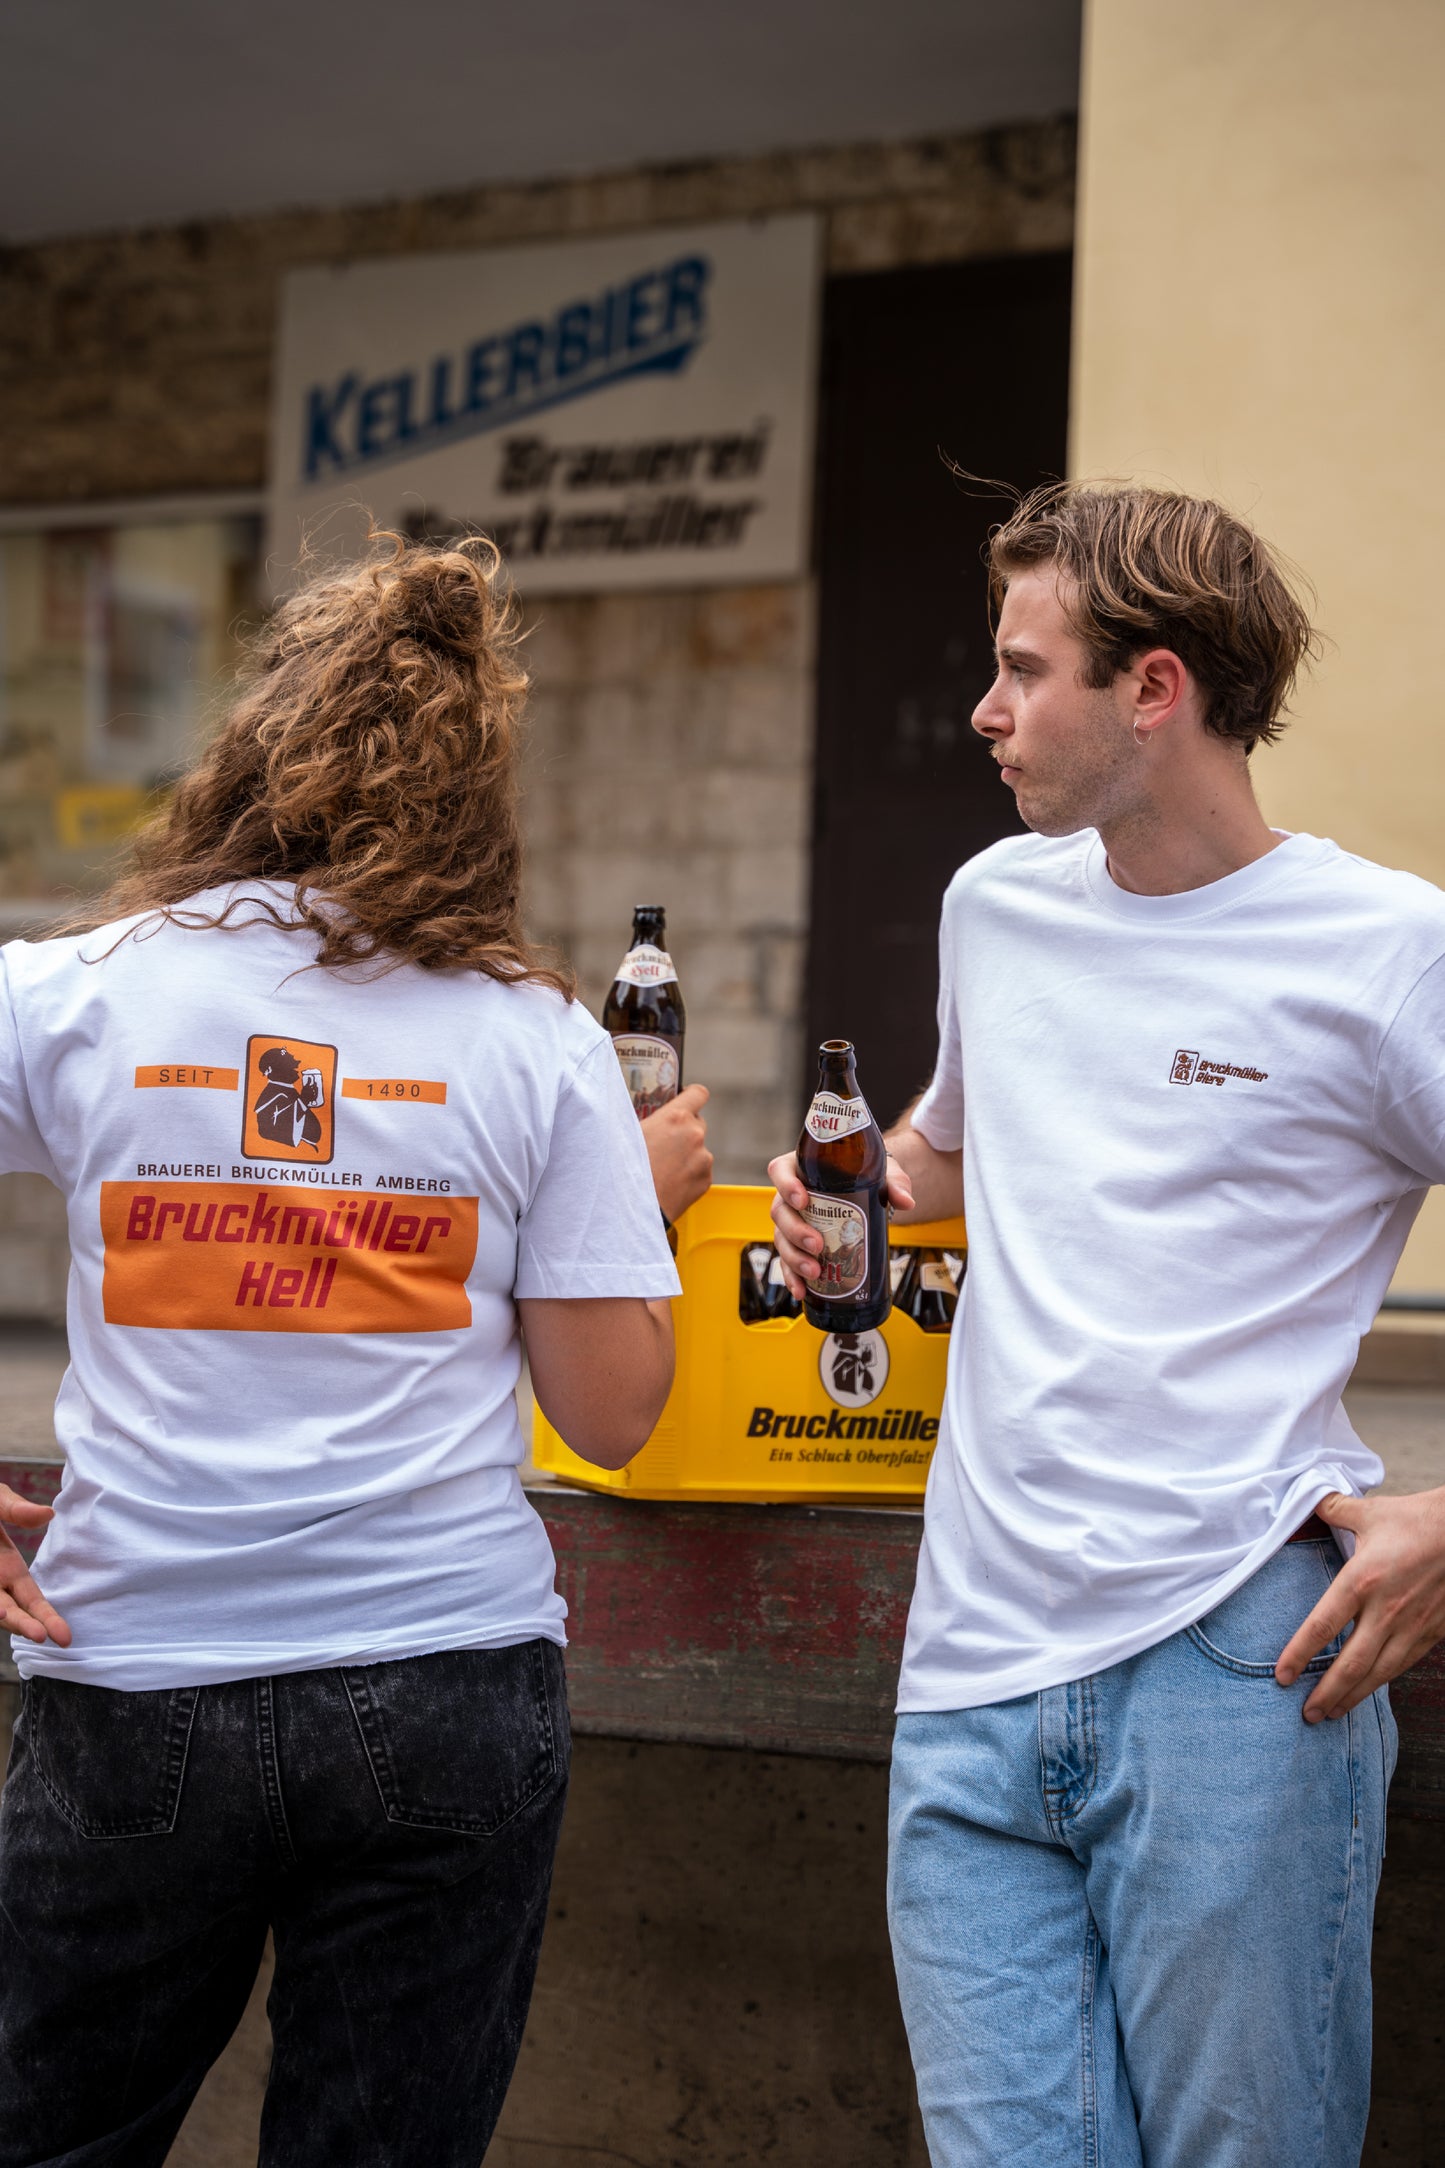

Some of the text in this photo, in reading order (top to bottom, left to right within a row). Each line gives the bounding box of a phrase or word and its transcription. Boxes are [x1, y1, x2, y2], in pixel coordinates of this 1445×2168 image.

[303, 252, 712, 482] KELLERBIER
[496, 417, 773, 495] Brauerei
[617, 1045, 670, 1060] ruckmüller
[158, 1068, 421, 1099] SEIT 1490
[1195, 1072, 1226, 1087] Biere
[1198, 1060, 1269, 1082] Bruckmüller
[810, 1114, 840, 1132] Hell
[136, 1163, 452, 1193] BRAUEREI BRUCKMÜLLER AMBERG
[125, 1192, 453, 1254] Bruckmüller
[234, 1257, 338, 1309] Hell
[746, 1406, 940, 1442] Bruckmülle
[769, 1448, 931, 1468] Ein Schluck Oberpfalz!
